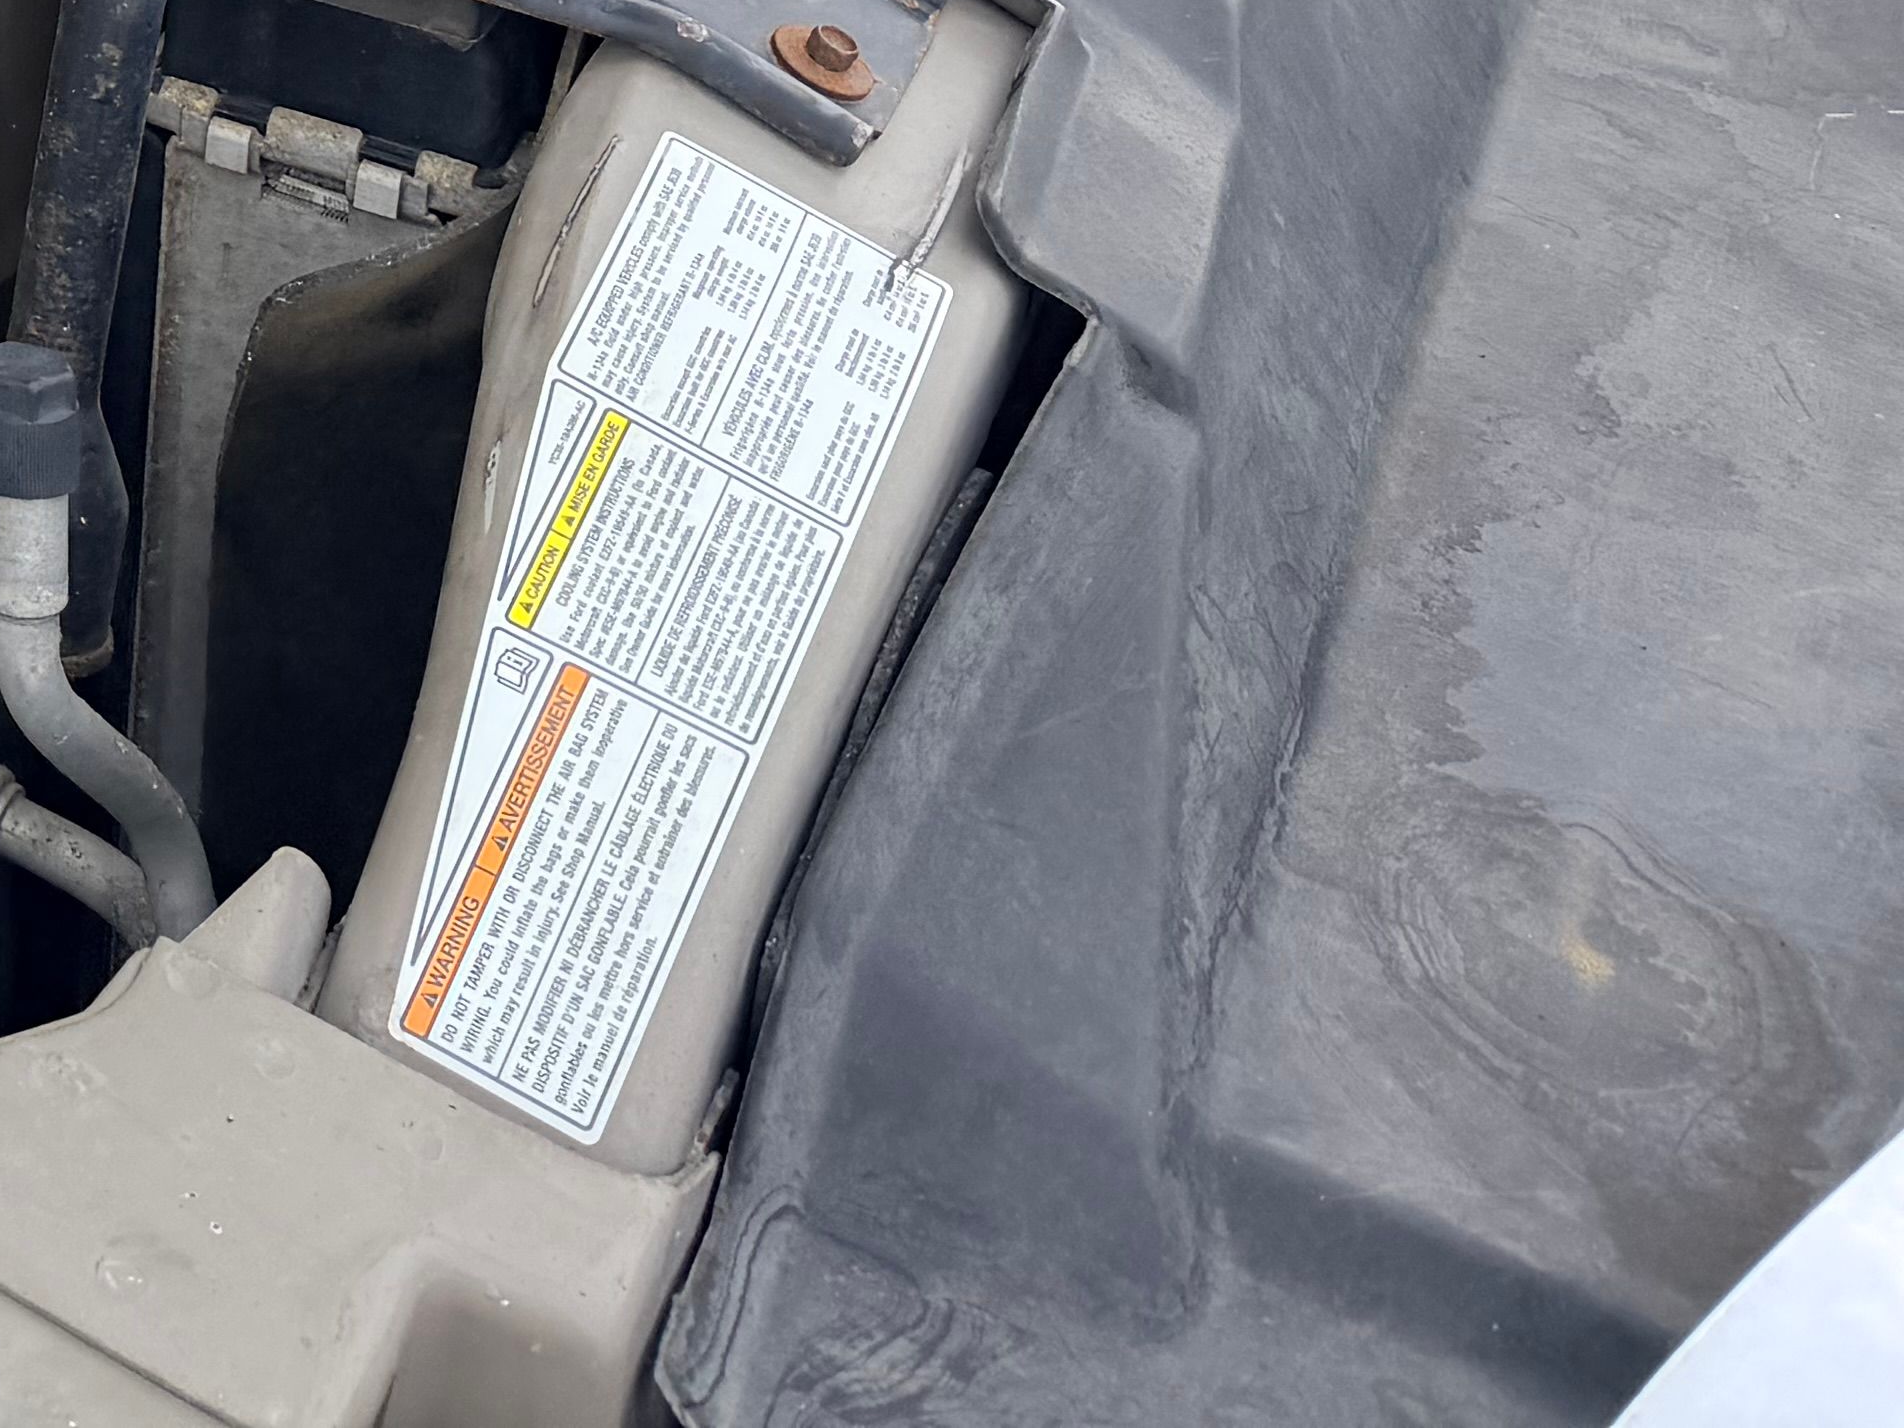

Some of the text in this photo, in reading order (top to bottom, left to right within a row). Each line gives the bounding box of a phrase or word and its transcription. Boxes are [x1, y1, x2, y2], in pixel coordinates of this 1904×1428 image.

[556, 458, 635, 607] COOLING SYSTEM INSTRUCTIONS
[568, 482, 590, 512] MISE
[583, 463, 599, 482] EN
[592, 421, 619, 462] GARDE
[527, 545, 559, 599] CAUTION
[500, 685, 573, 832] AVERTISSEMENT
[441, 689, 608, 1043] DO NOT TAMPER WITH DISCONNECT THE AIR BAG SYSTEM
[483, 699, 627, 1000] You could the bags make them inoperative
[521, 723, 678, 1062] PAS MODIFIER DÉBRANCHER LE CÂBLAGE ÉLECTRIQUE DU
[533, 760, 686, 1093] DISPOSITIF D'UN SAC GONFLABLE. Cela pourrait les
[427, 896, 479, 987] WARNING
[483, 801, 605, 1064] which may result injury. See Shop Manual.
[587, 887, 654, 1021] les mettre hors service
[571, 938, 657, 1114] Voir manuel de réparation.
